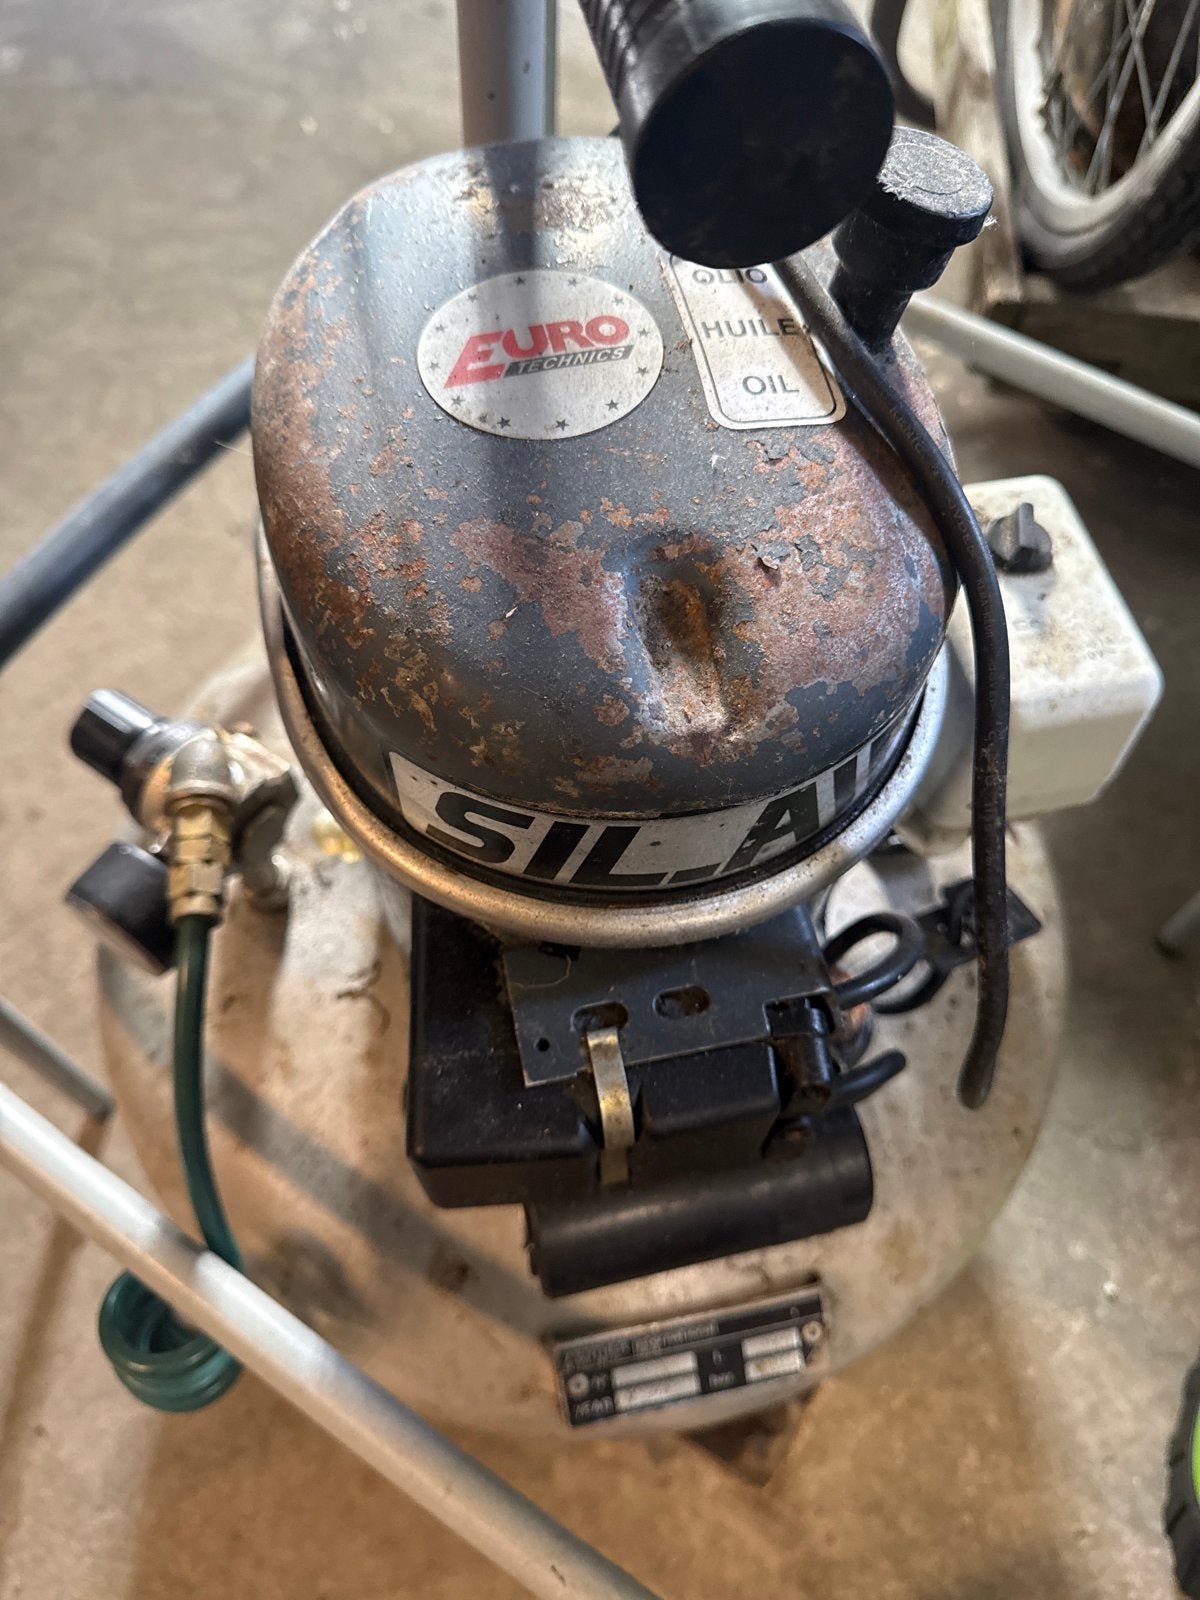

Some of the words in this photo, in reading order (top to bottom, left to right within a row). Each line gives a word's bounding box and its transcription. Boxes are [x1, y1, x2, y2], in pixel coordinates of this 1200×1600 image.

[701, 318, 799, 338] HUILE
[444, 315, 630, 389] EURO
[517, 346, 626, 375] TECHNICS
[742, 375, 800, 395] OIL
